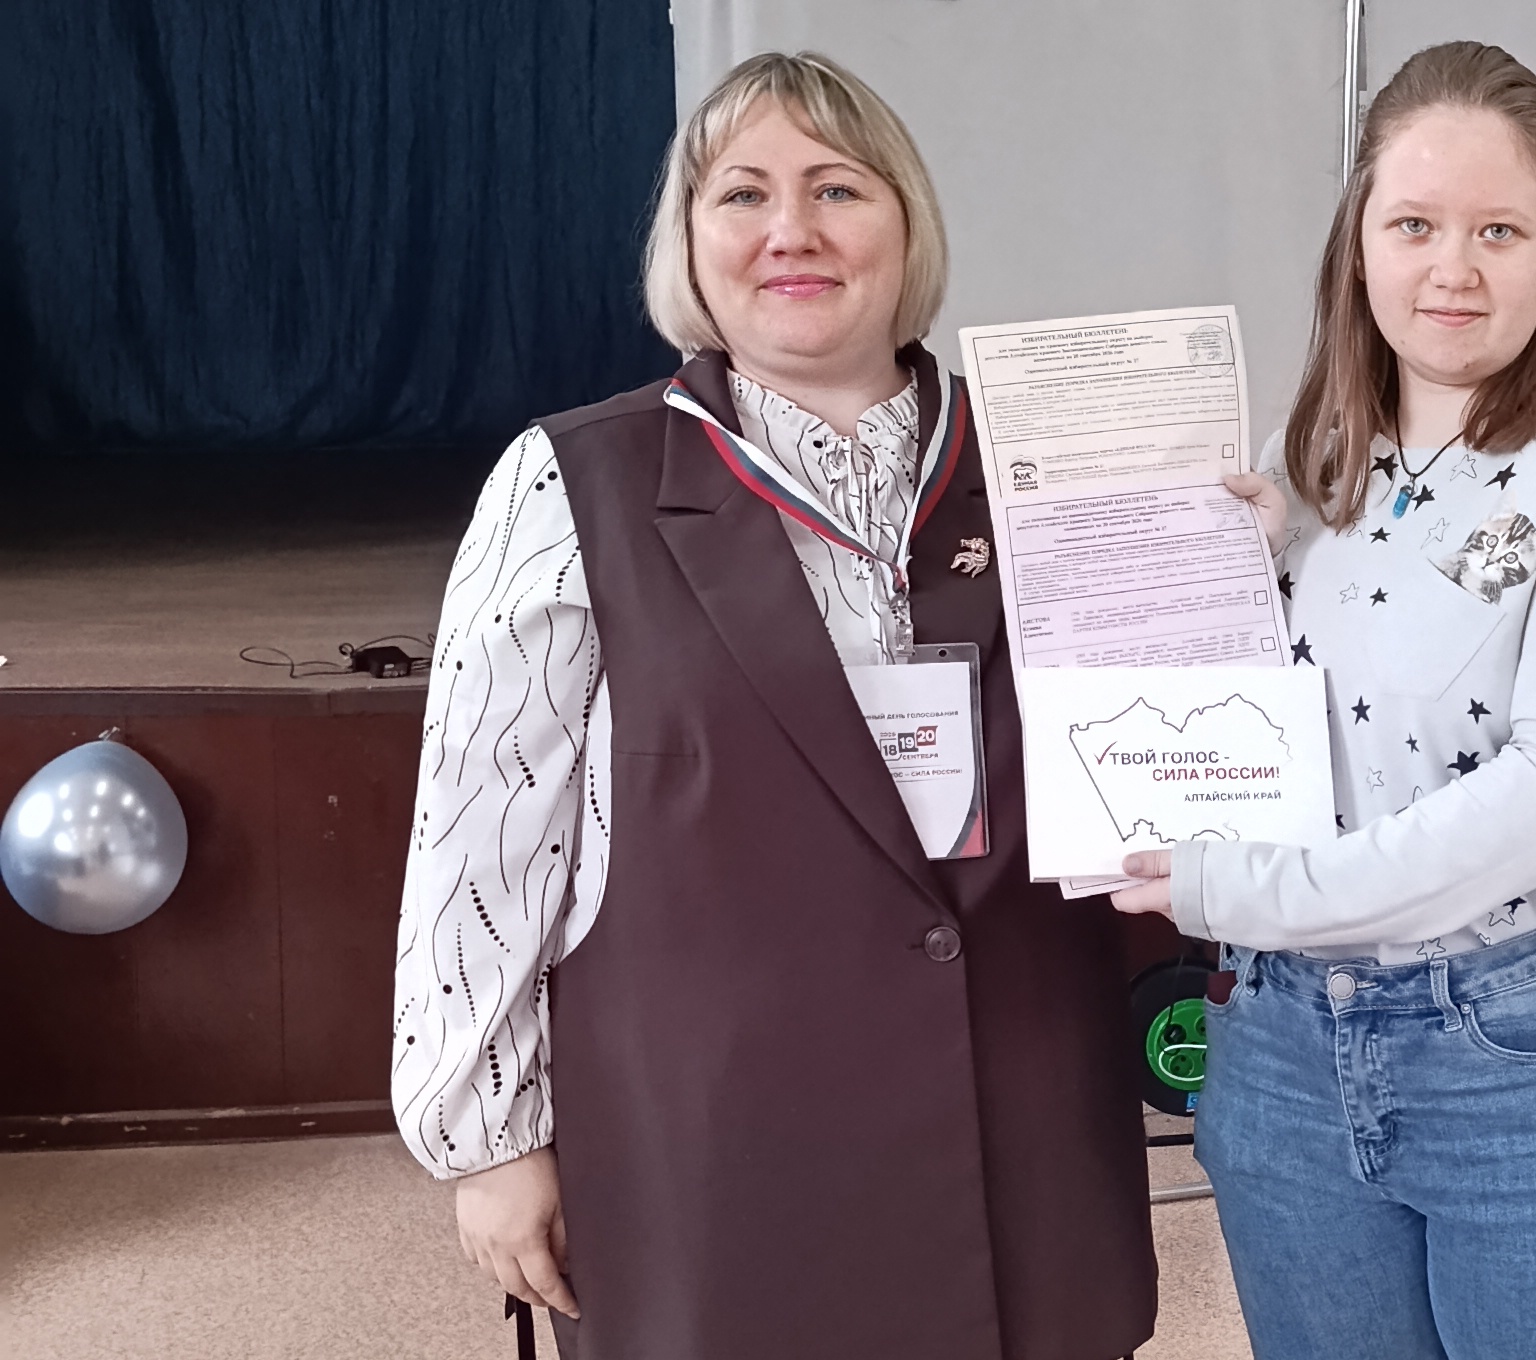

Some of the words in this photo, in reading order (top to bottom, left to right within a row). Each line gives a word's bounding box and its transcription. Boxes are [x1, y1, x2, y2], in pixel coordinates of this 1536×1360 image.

[907, 711, 959, 719] ГОЛОСОВАНИЯ
[883, 744, 898, 756] 18
[899, 736, 915, 749] 19
[916, 730, 935, 743] 20
[1109, 749, 1157, 765] ТВОЙ
[1162, 751, 1219, 764] ГОЛОС
[1152, 768, 1199, 781] СИЛА
[1205, 766, 1280, 780] РОССИИ!
[1184, 790, 1250, 802] АЛТАЙСКИЙ
[1253, 790, 1281, 800] КРАЙ
